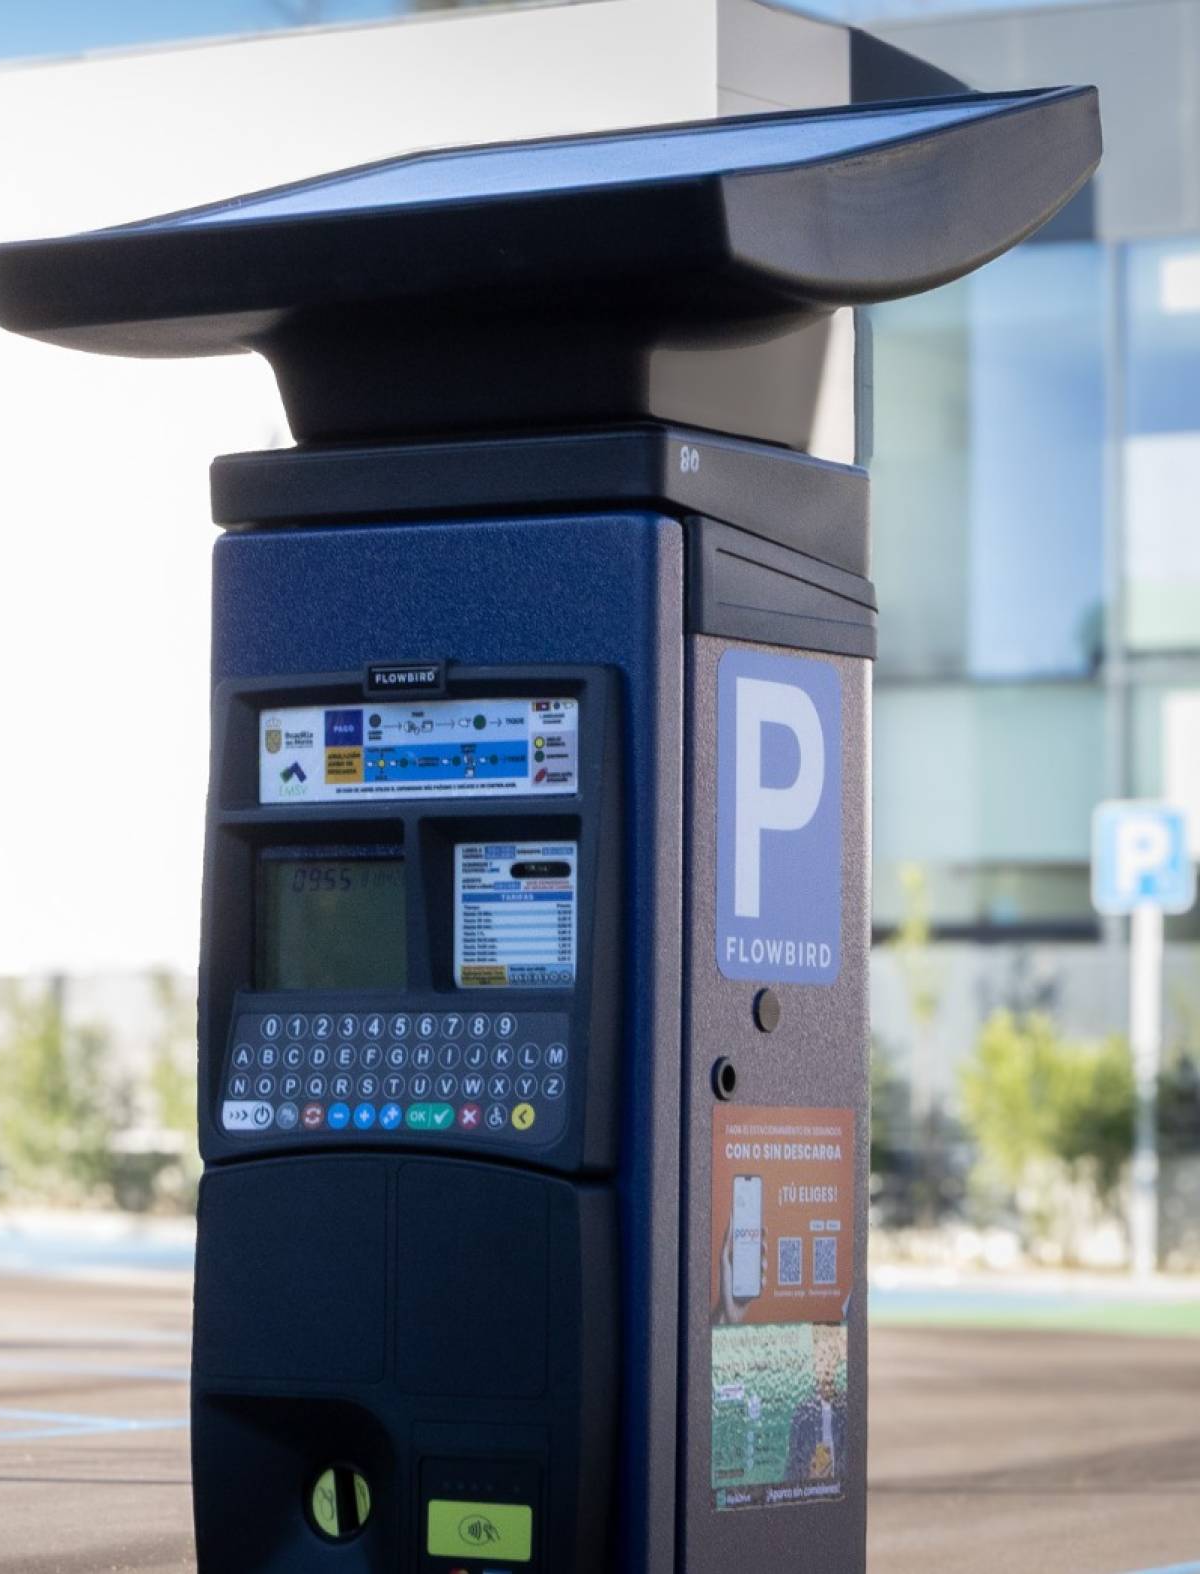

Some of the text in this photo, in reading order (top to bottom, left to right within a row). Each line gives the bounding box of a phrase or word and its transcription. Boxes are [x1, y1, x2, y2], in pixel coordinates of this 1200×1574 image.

[375, 671, 435, 684] FLOWBIRD
[734, 676, 825, 918] P
[1116, 820, 1171, 896] P
[726, 936, 831, 968] FLOWBIRD
[266, 1018, 511, 1036] 0 1 2 3 4 5 6 7 8 9
[237, 1050, 563, 1064] A B C D E F G H I J K L M
[234, 1079, 558, 1094] N O P Q R S T U V W X Y Z
[410, 1111, 426, 1121] OK
[726, 1143, 842, 1160] CON O SIN DESCARGA
[779, 1181, 838, 1207] ¡TÚ ELIGES!
